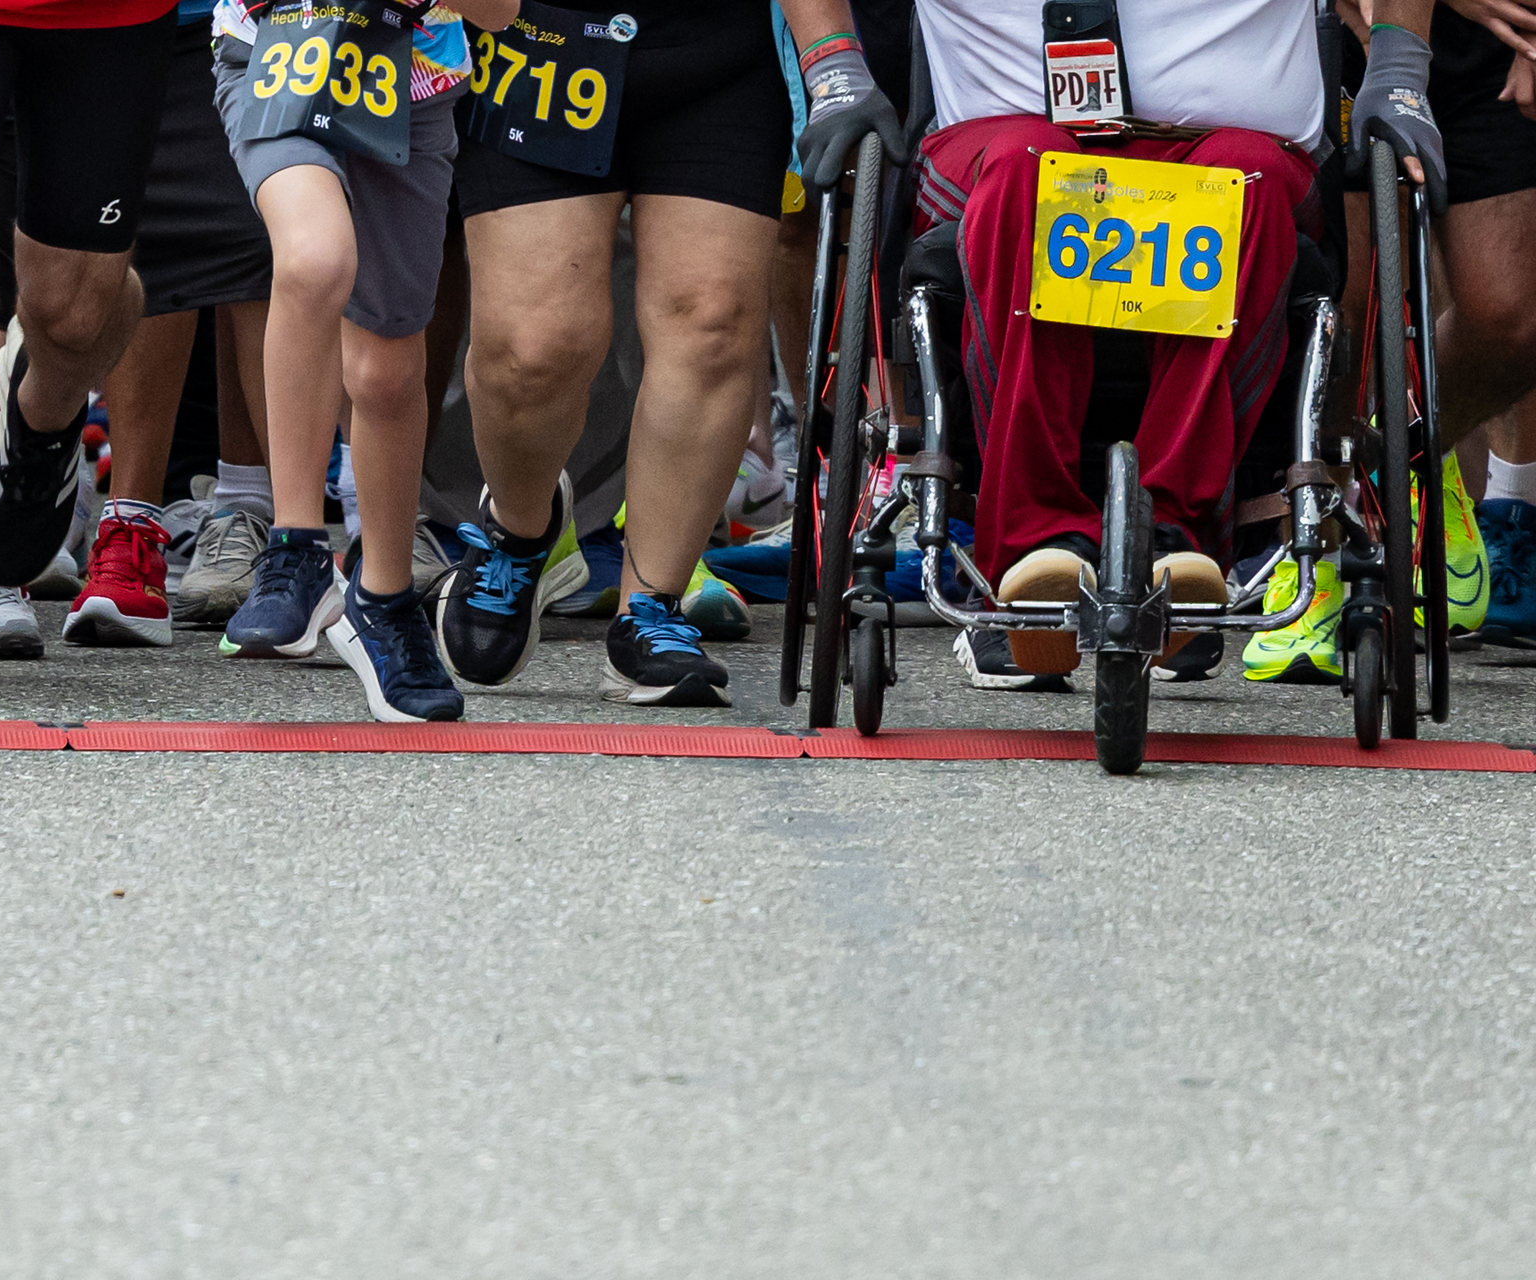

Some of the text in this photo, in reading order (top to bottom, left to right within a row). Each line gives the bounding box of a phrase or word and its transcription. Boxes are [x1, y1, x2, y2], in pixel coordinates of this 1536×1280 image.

[270, 10, 303, 26] Heart
[312, 5, 345, 21] Soles
[254, 35, 398, 118] 3933
[471, 29, 608, 131] 3719
[312, 113, 332, 128] 5K
[508, 127, 524, 144] 5K
[1048, 213, 1223, 293] 6218
[1121, 298, 1144, 314] 10K
